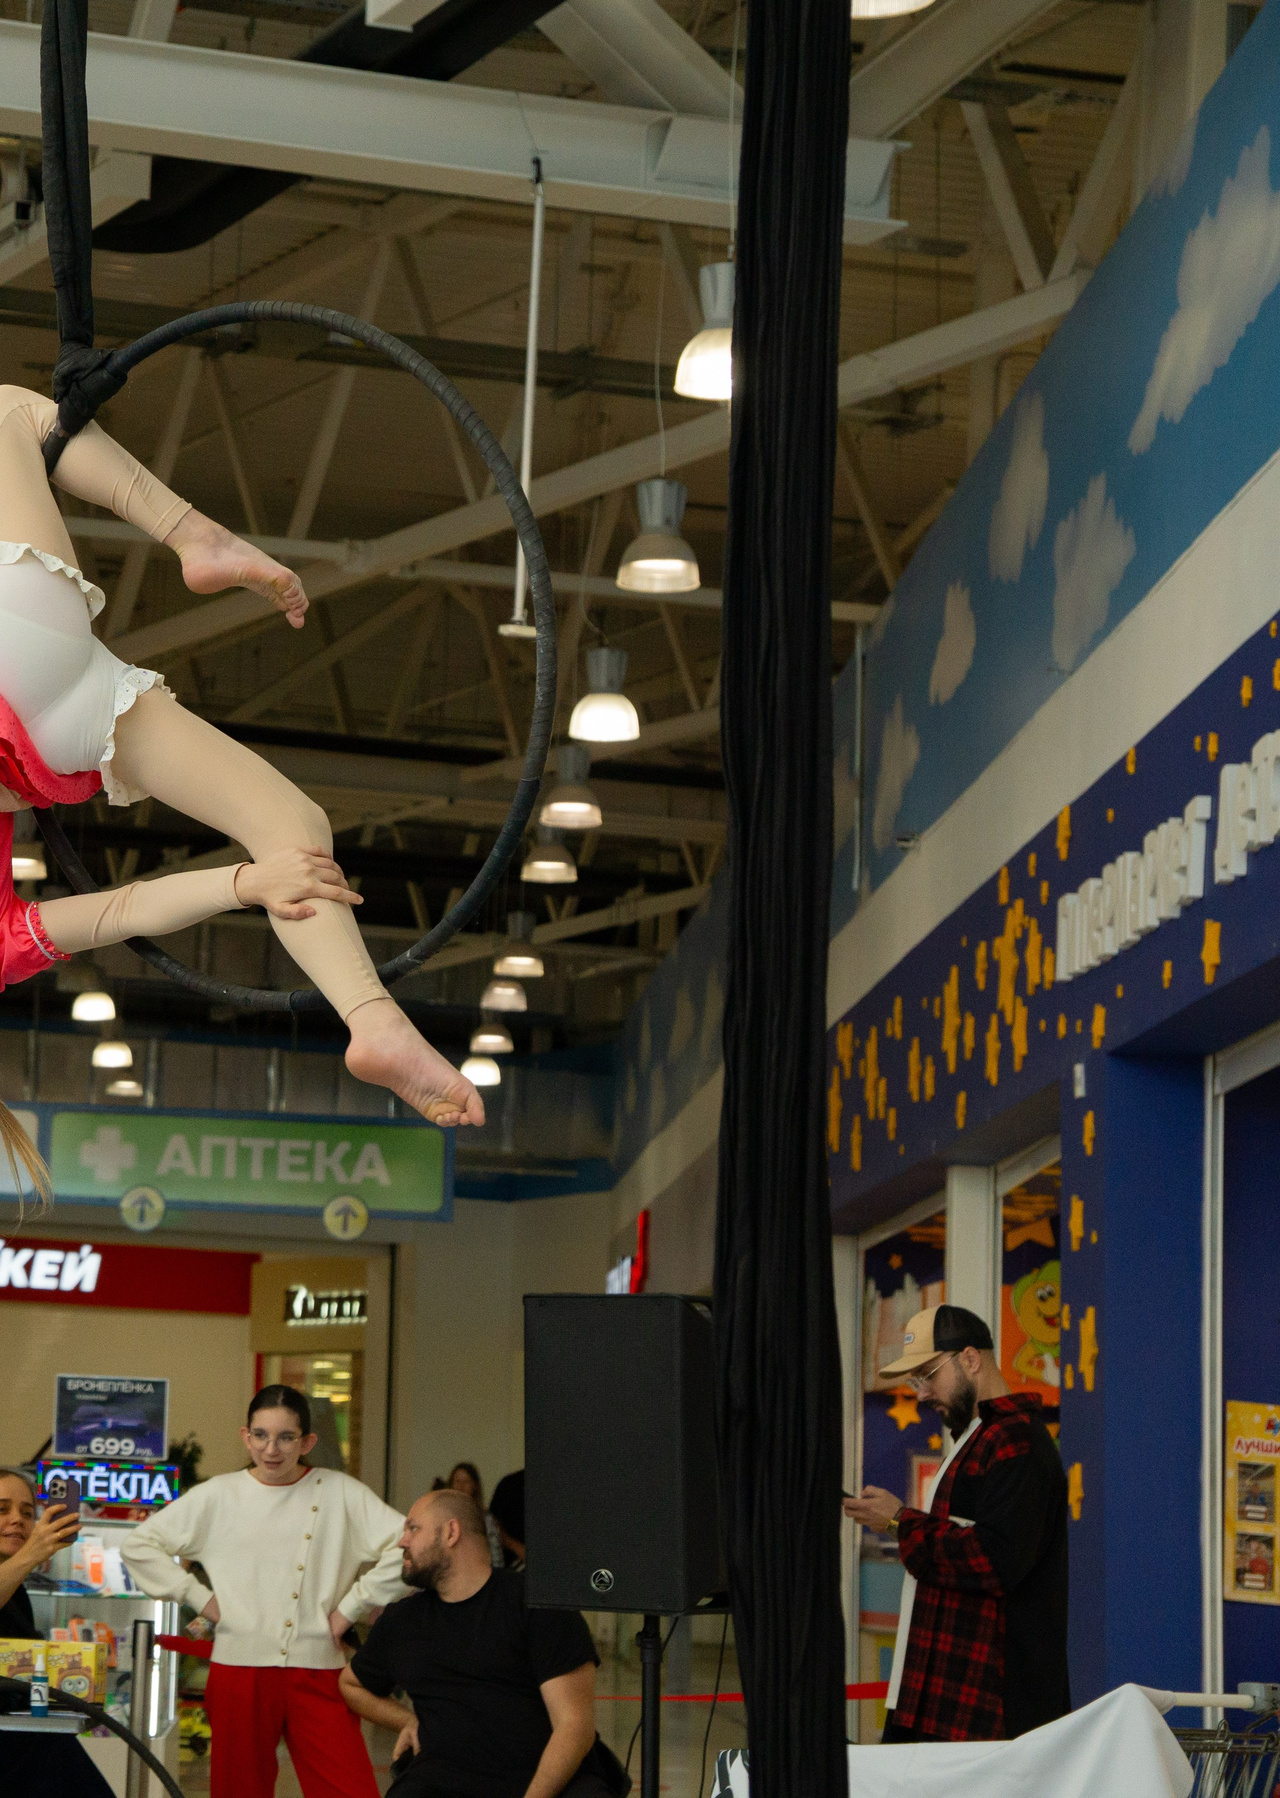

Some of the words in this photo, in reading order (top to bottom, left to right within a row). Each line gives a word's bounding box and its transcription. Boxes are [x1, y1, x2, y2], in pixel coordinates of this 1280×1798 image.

[156, 1134, 393, 1187] АПТЕКА
[66, 1379, 155, 1394] БРОНЕПЛЁНКА
[89, 1437, 136, 1456] 699
